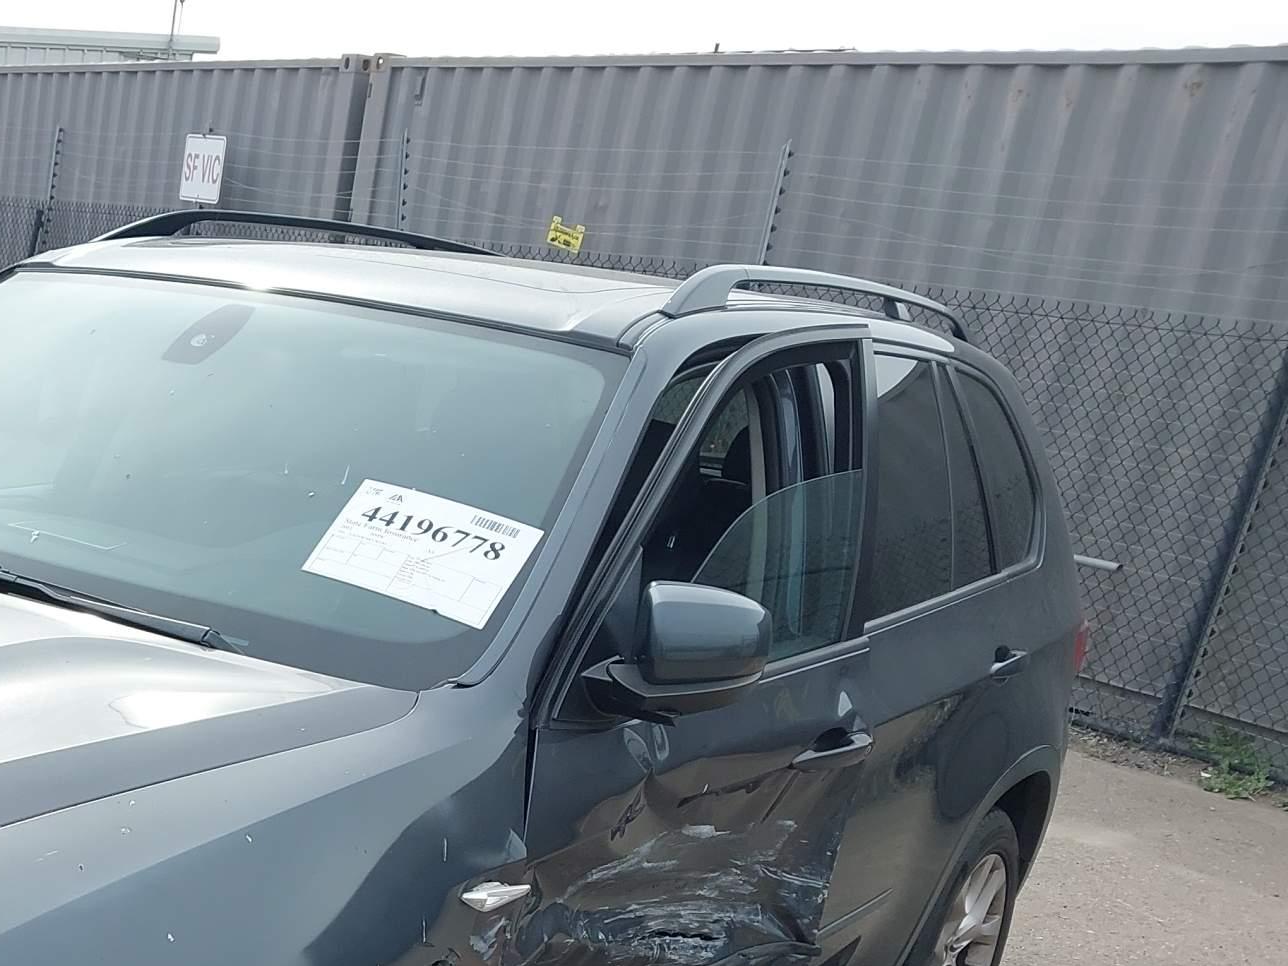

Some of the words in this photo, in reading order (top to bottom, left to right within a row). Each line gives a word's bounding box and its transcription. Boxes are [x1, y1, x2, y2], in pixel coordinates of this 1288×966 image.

[185, 152, 200, 182] SF
[202, 153, 221, 184] VIC
[361, 506, 506, 560] 44196778
